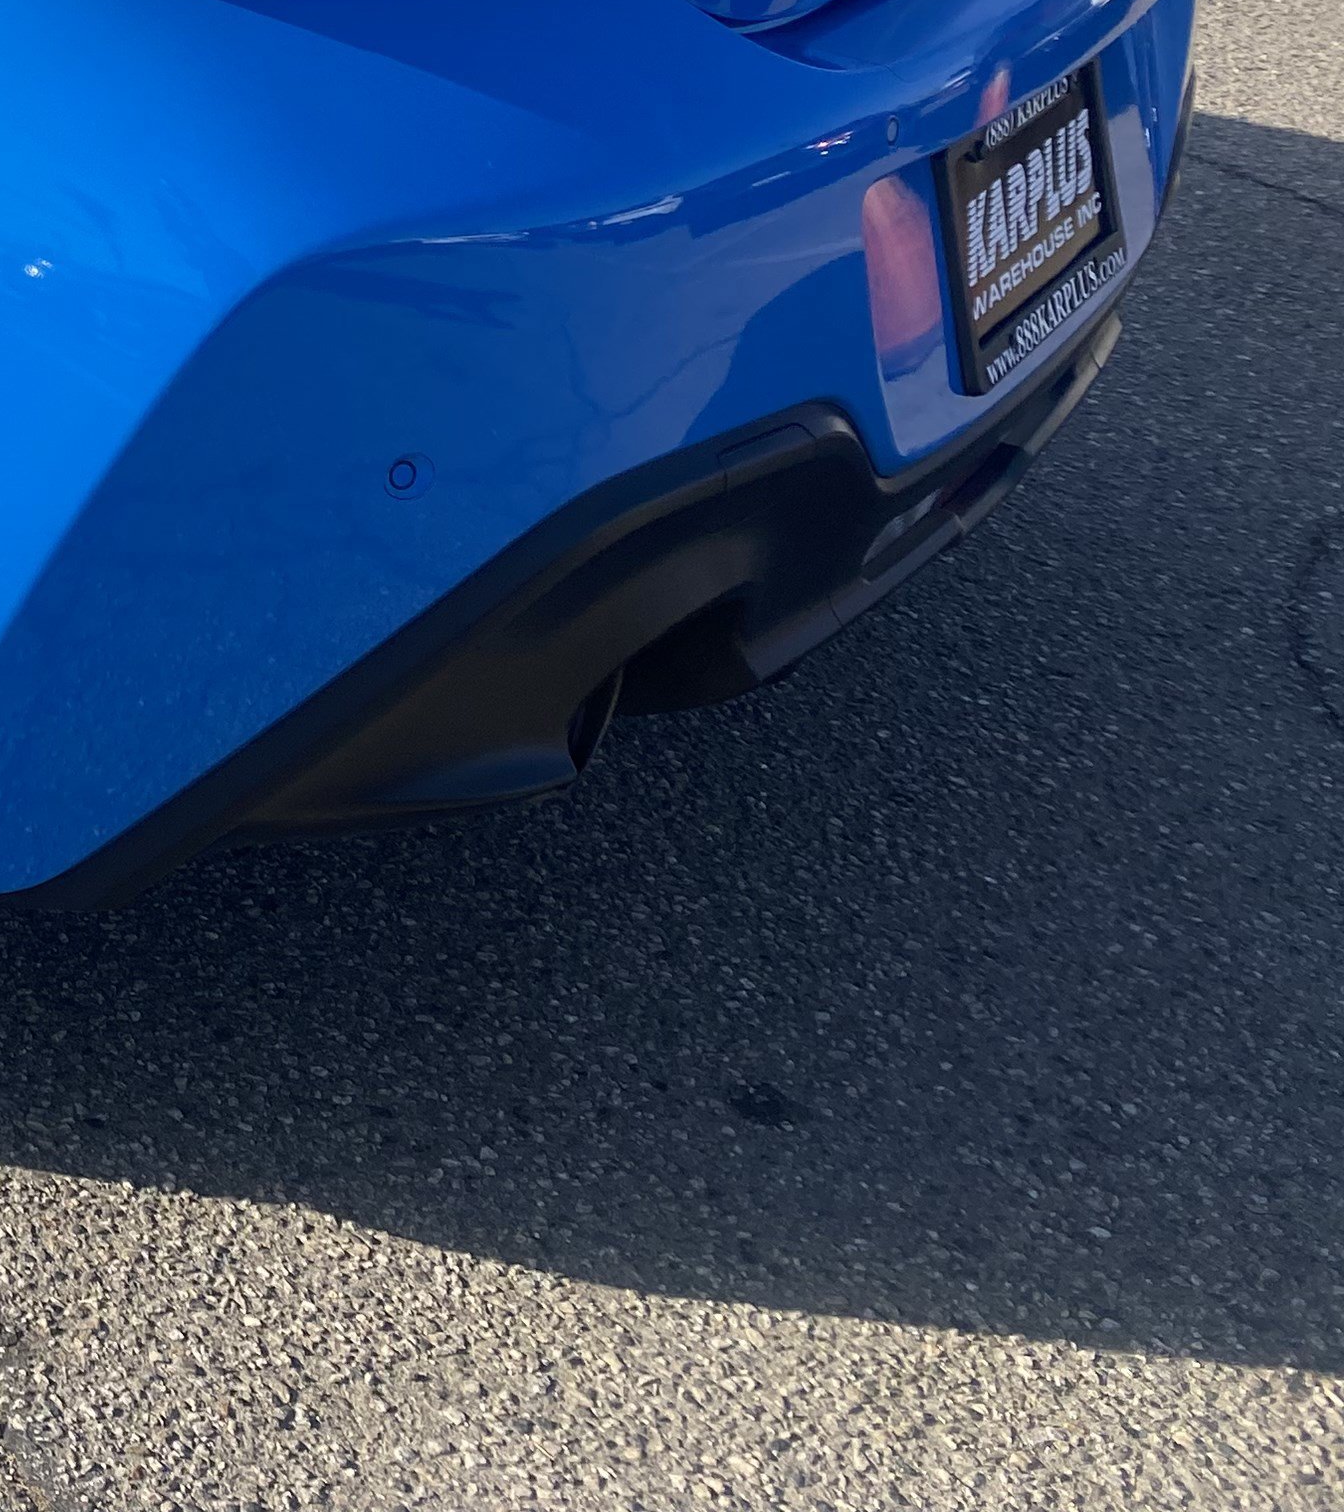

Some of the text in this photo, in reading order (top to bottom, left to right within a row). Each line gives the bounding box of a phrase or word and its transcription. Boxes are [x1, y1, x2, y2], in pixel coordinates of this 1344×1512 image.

[967, 108, 1093, 287] KARPLUS
[973, 191, 1102, 321] WAREHOUSE INC
